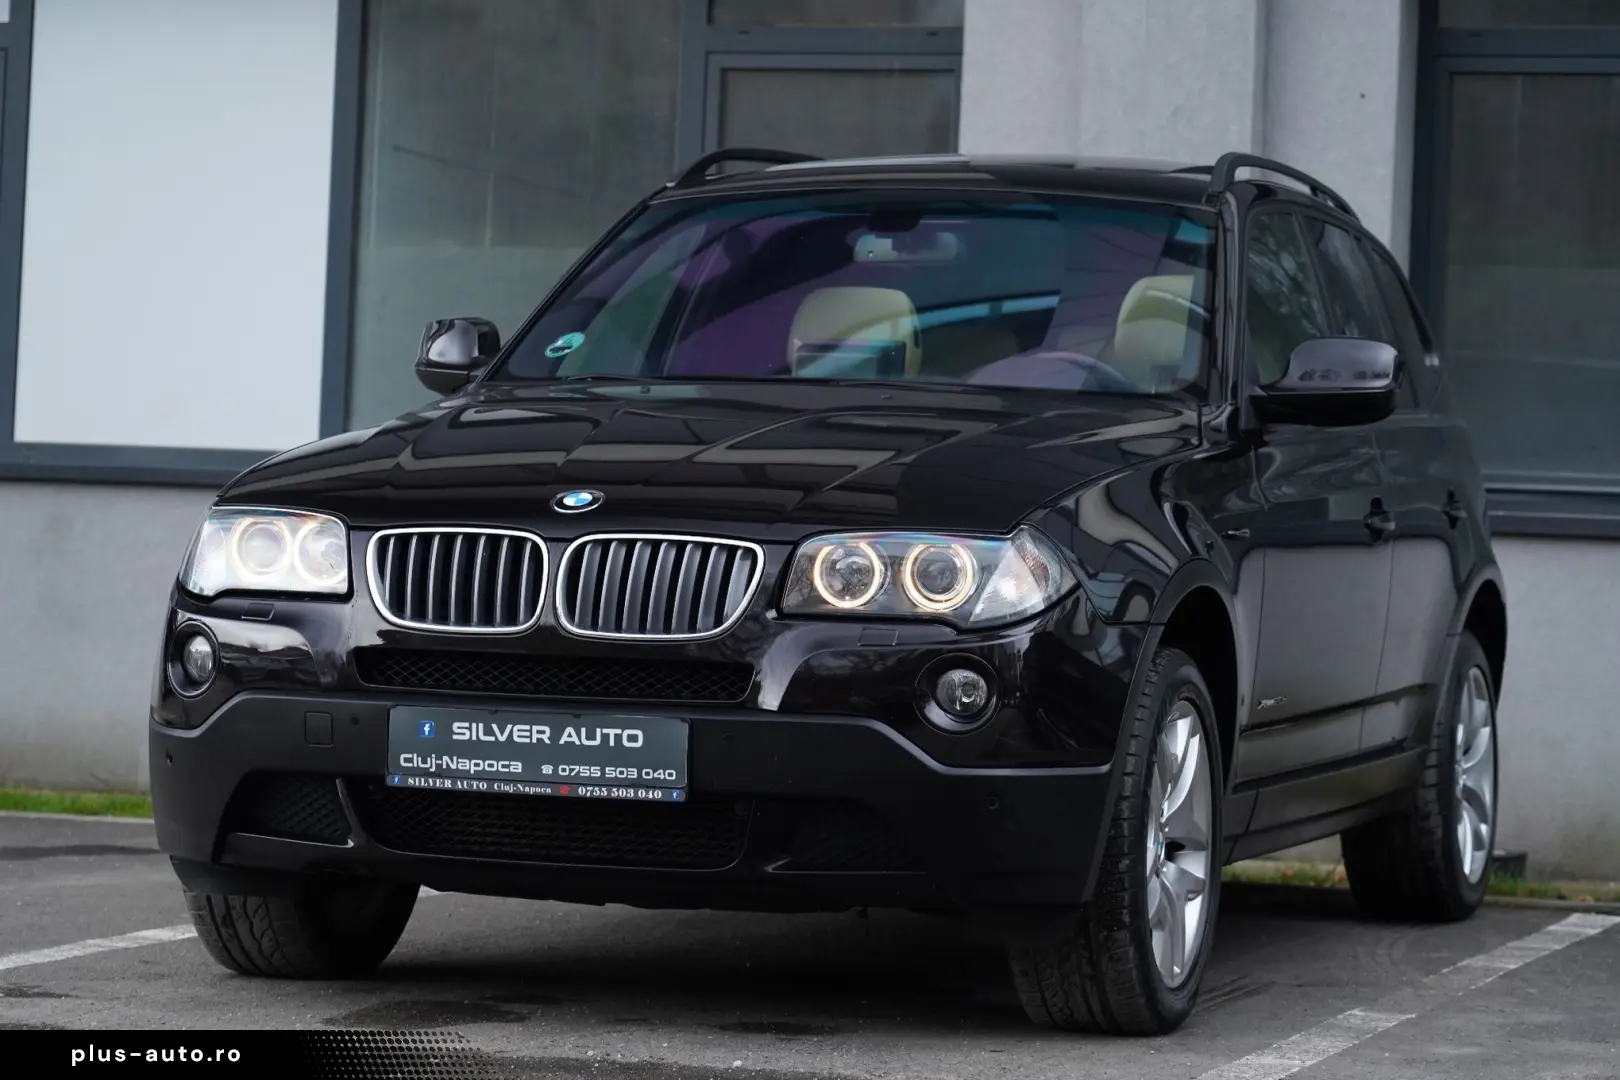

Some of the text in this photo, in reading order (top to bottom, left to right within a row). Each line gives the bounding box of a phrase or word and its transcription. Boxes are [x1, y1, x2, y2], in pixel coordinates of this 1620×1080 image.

[452, 721, 551, 744] SILVER
[558, 727, 644, 748] AUTO
[399, 753, 522, 773] Cluj-Napoca
[558, 765, 676, 780] 0755 503 040
[407, 777, 452, 788] SILVER
[455, 780, 487, 790] AUTO
[494, 782, 552, 794] Cluj-Napoca
[578, 786, 608, 797] 0755
[611, 787, 635, 798] 503
[637, 788, 662, 799] 040
